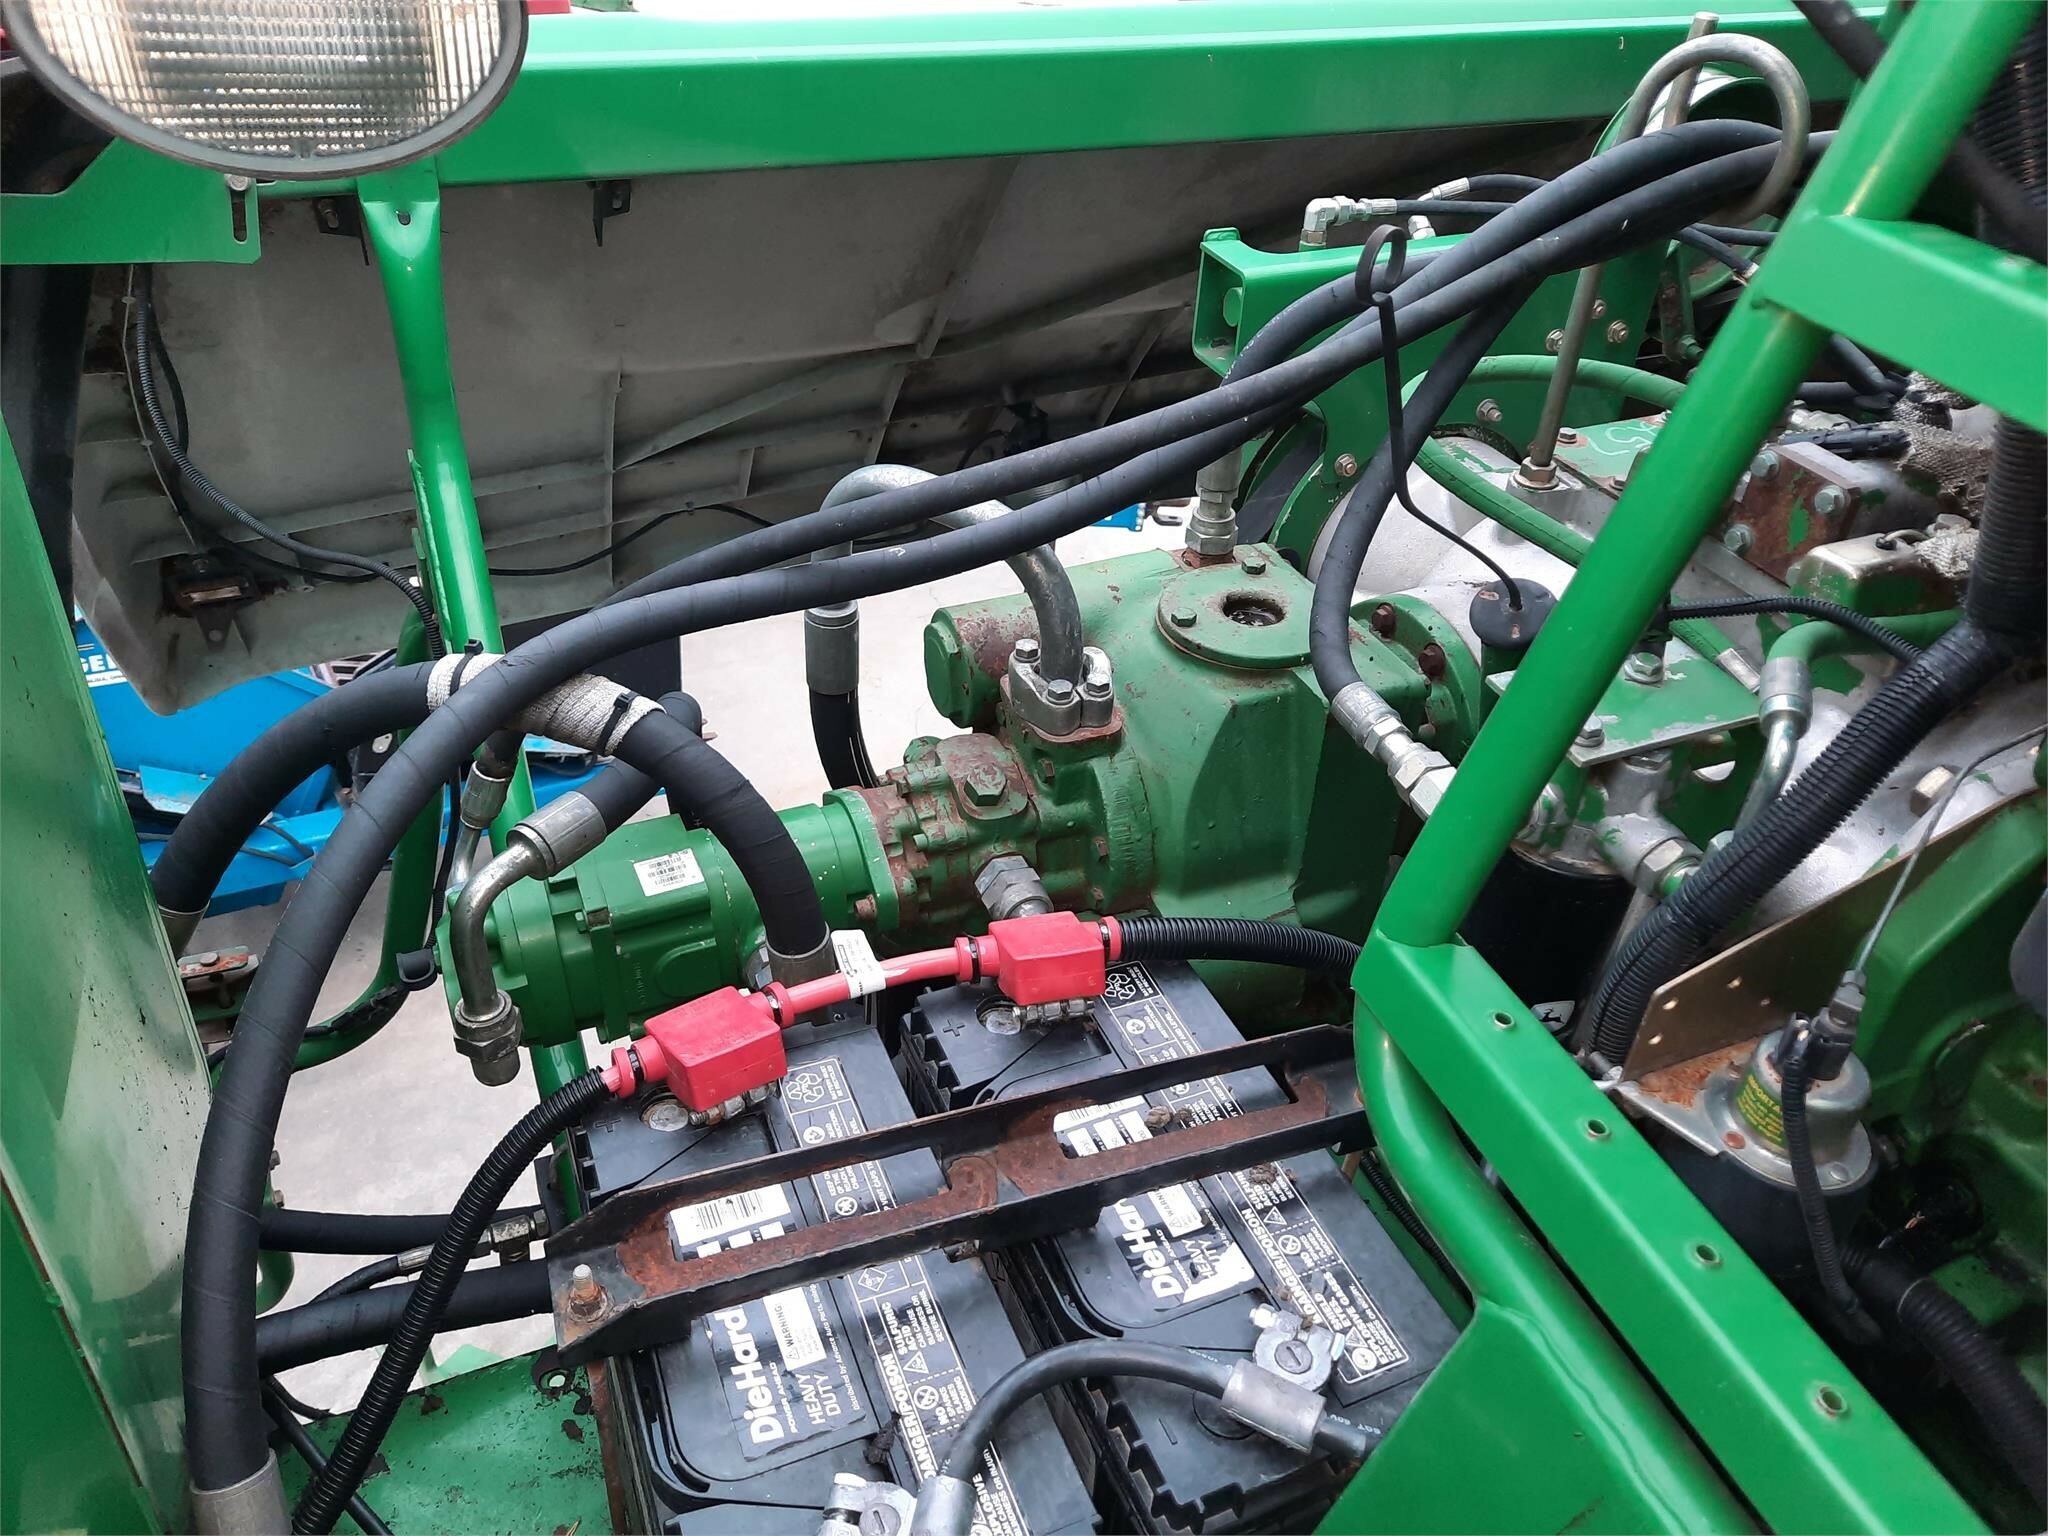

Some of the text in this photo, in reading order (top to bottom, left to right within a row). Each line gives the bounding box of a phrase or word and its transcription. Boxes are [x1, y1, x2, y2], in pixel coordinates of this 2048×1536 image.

[825, 1179, 837, 1196] KEEP
[831, 1172, 844, 1194] OF THE
[868, 1170, 881, 1187] CAPS
[1234, 1170, 1264, 1209] SULFURI
[1253, 1183, 1272, 1206] ACID
[1112, 1197, 1184, 1298] DieHar
[1156, 1228, 1177, 1257] AHEAD
[1240, 1207, 1317, 1315] DANGER/POISON
[1299, 1250, 1315, 1267] NO
[910, 1294, 920, 1305] OR
[1312, 1291, 1344, 1330] SHIELD
[822, 1321, 833, 1336] Auto
[880, 1300, 908, 1355] SULFURIC
[905, 1307, 927, 1348] CAN CAUSE
[1321, 1270, 1389, 1364] EXPLOSIVE GASES
[828, 1336, 843, 1363] Advance
[900, 1323, 918, 1351] ACID
[713, 1304, 784, 1443] DieHard
[769, 1361, 798, 1433] POWER AHEAD
[795, 1372, 825, 1424] HEAVY
[813, 1371, 841, 1416] DUTY
[934, 1405, 949, 1425] NO
[992, 1476, 1003, 1490] OR
